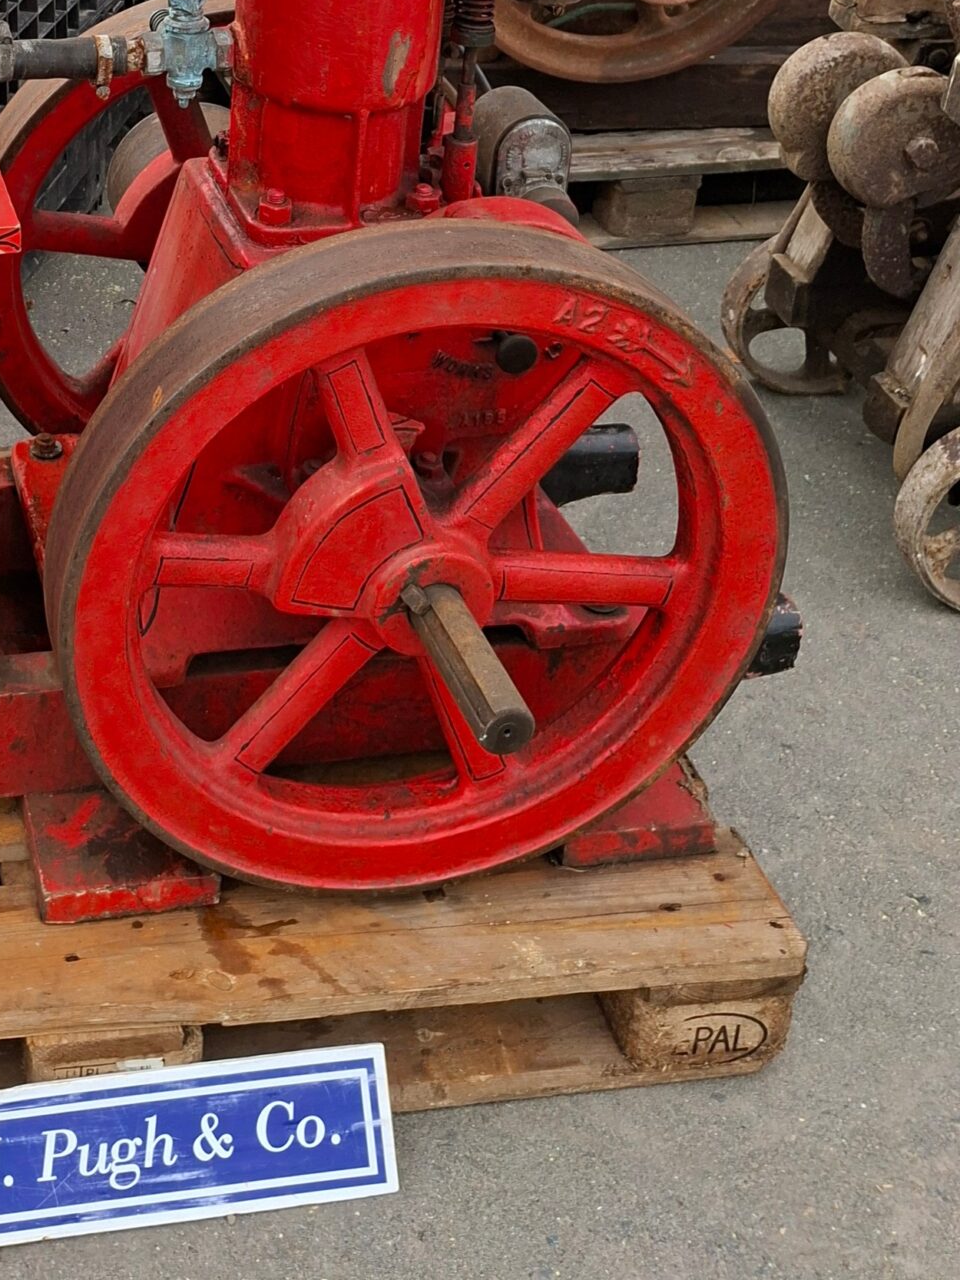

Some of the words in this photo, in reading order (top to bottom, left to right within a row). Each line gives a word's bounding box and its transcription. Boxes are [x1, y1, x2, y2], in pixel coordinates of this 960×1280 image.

[37, 1113, 178, 1191] Pugh
[192, 1112, 234, 1162] &
[256, 1100, 341, 1153] Co.
